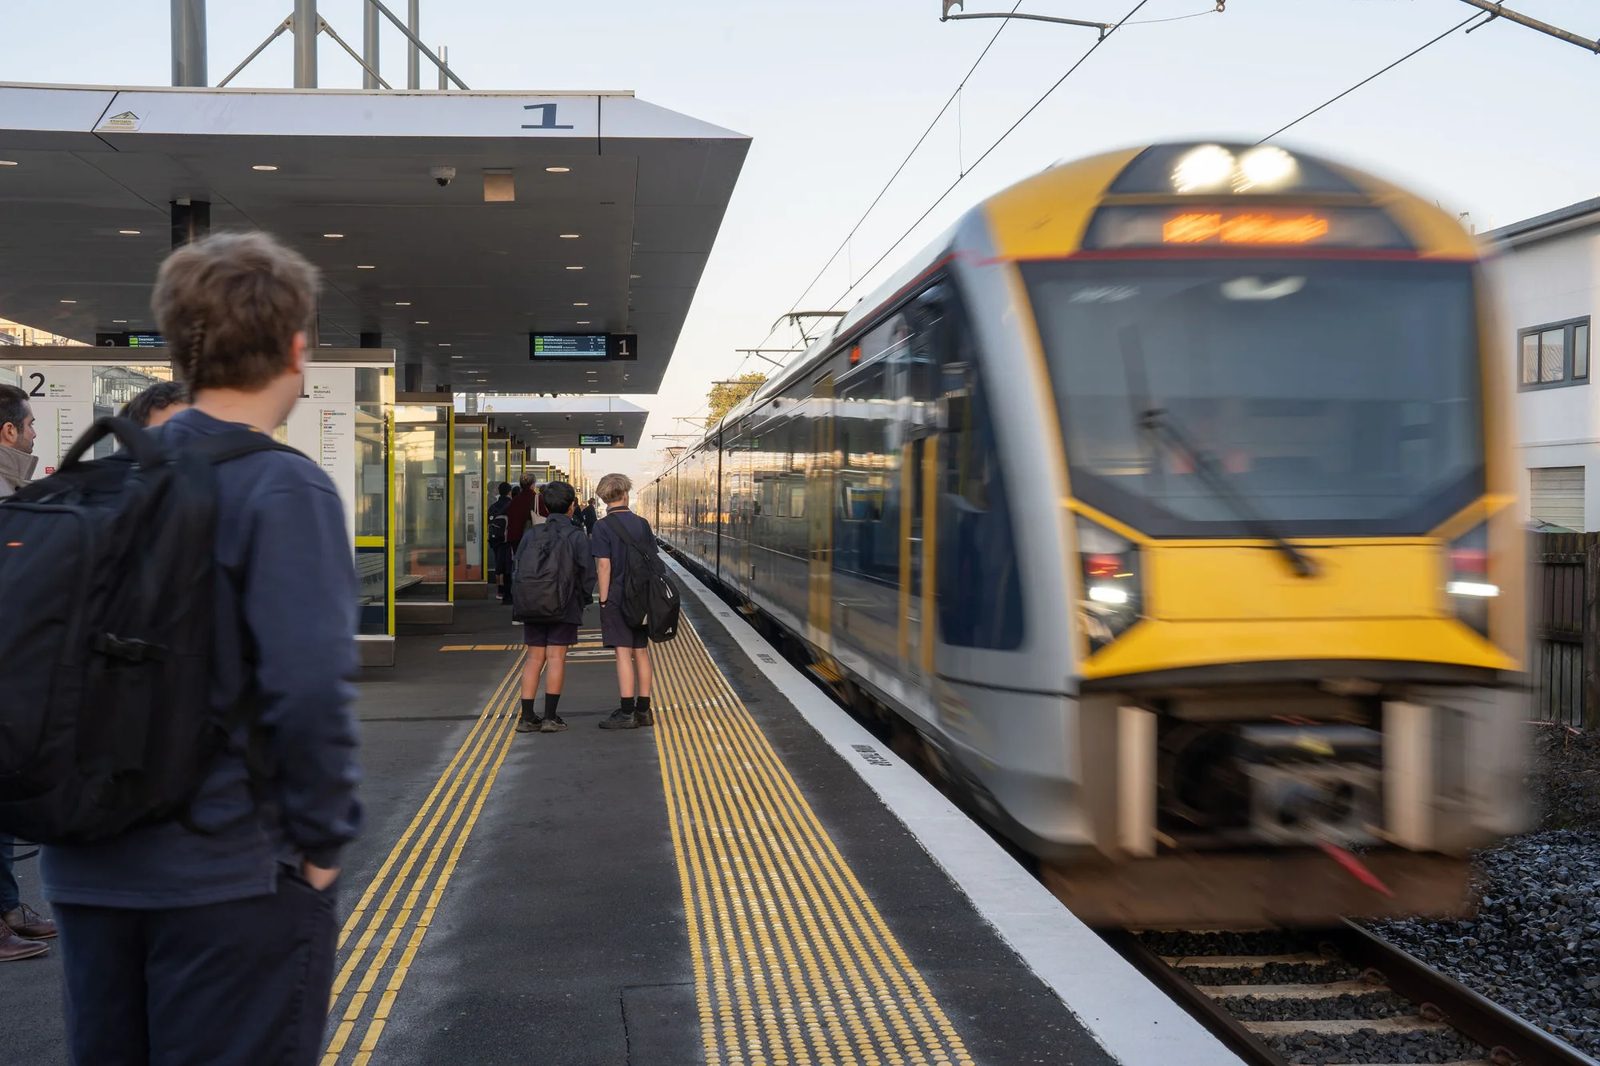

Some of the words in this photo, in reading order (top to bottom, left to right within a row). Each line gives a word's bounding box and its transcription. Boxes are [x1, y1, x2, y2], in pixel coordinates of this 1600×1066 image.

[521, 103, 574, 129] 1
[619, 340, 629, 355] 1
[29, 372, 46, 397] 2
